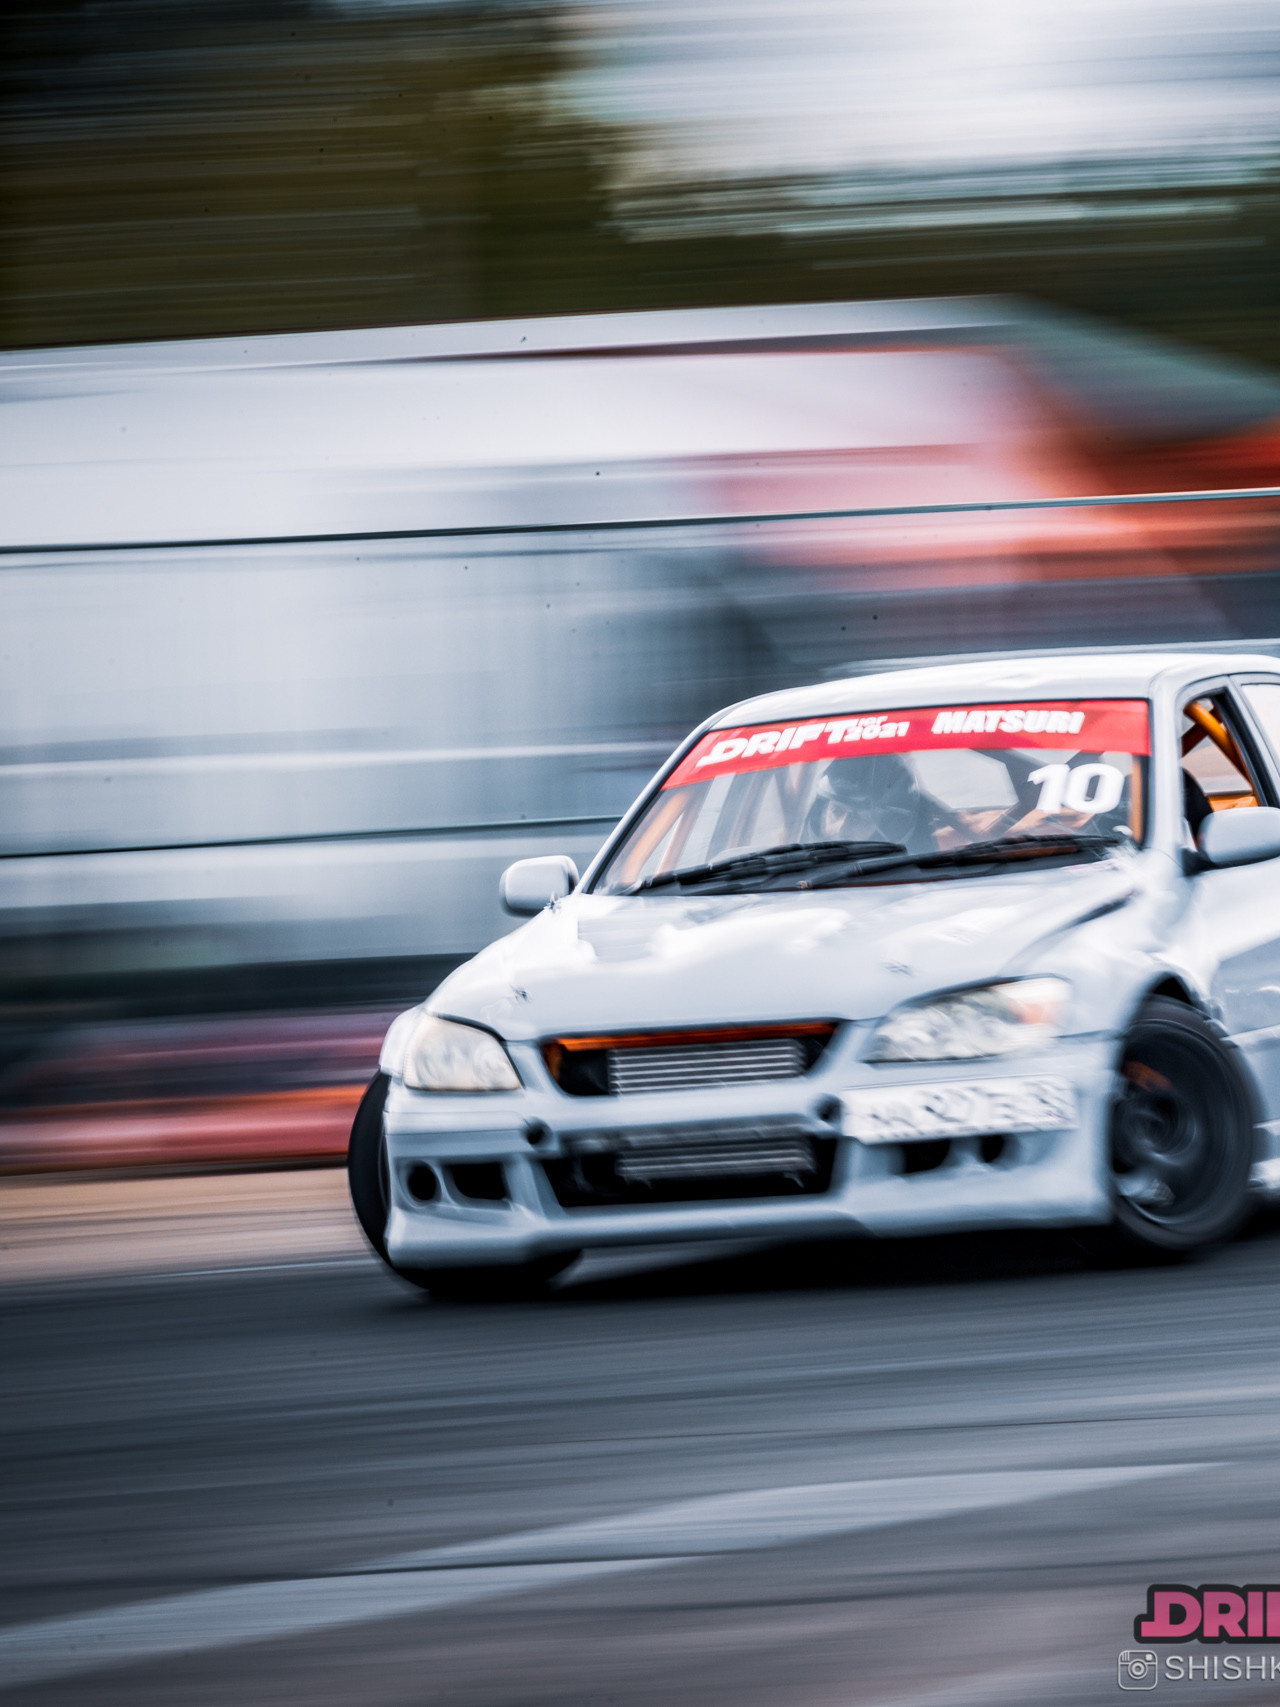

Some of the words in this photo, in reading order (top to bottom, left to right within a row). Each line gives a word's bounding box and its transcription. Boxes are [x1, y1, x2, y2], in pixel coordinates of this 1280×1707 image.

[695, 718, 859, 768] DRIFT
[843, 721, 910, 743] 2021
[931, 710, 1085, 734] MATSURI
[1027, 763, 1124, 814] 10
